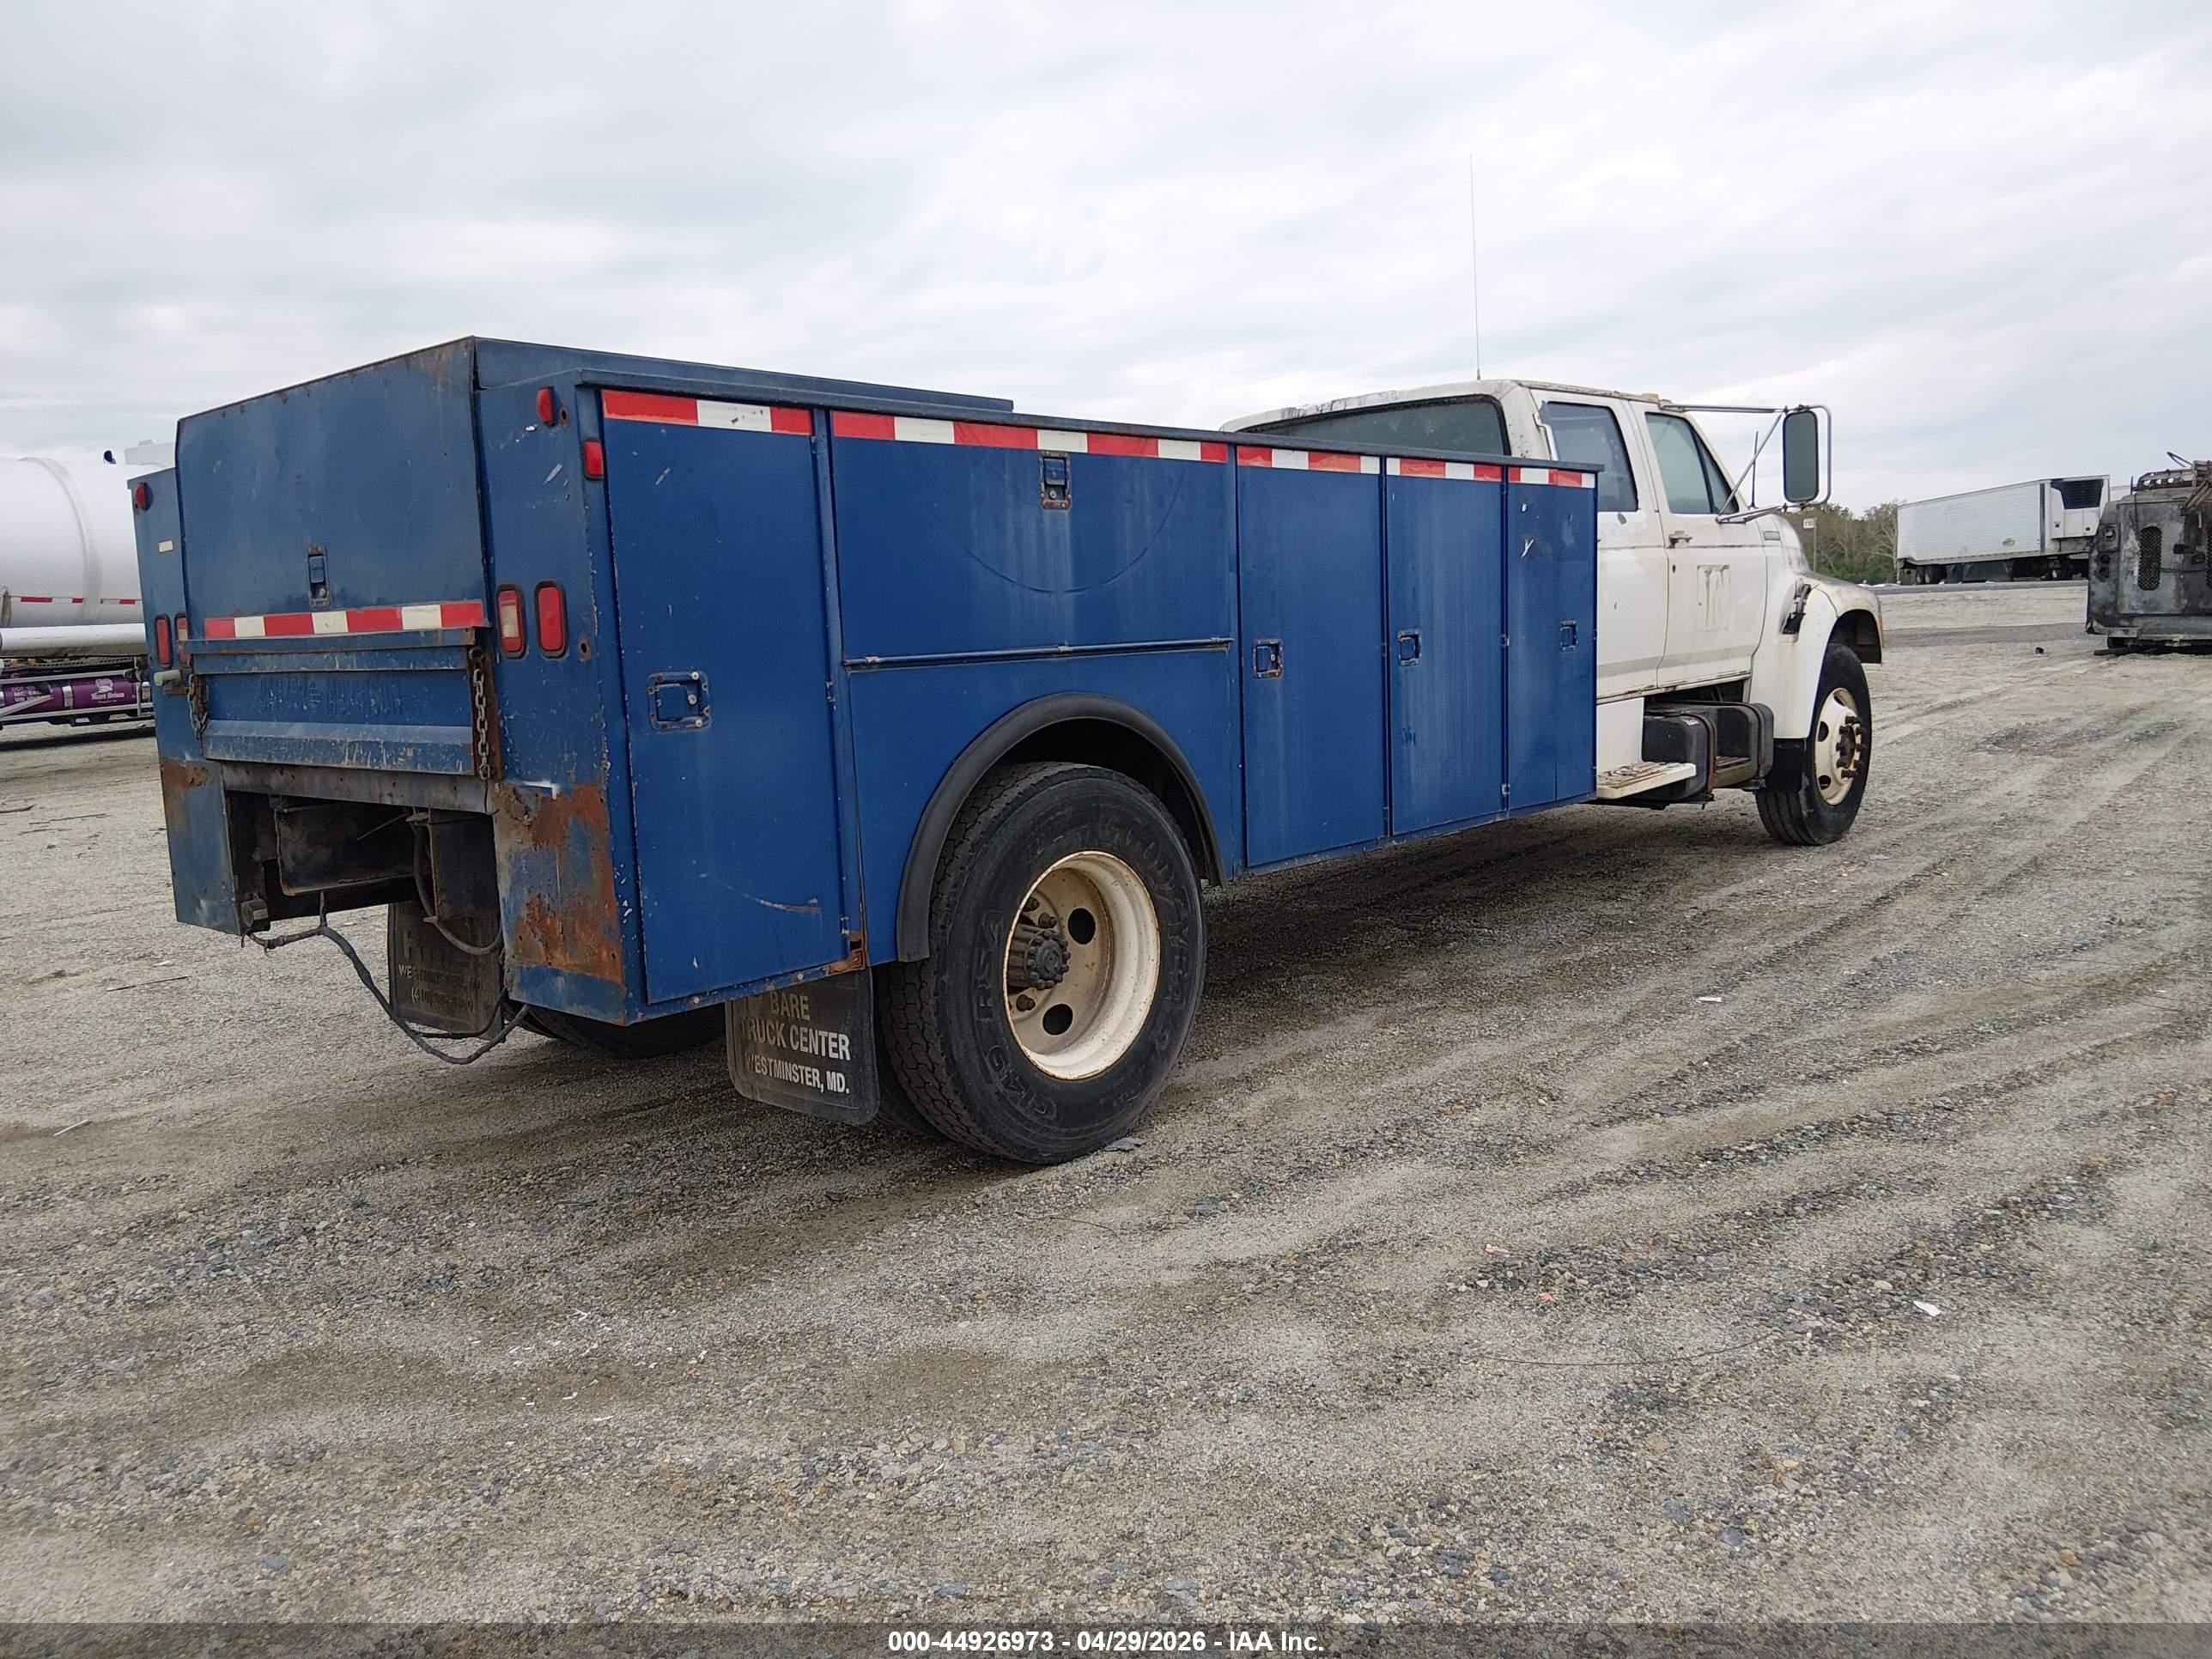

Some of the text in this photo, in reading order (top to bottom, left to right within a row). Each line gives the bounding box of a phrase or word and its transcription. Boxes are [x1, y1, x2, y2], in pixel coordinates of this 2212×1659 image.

[769, 991, 811, 1021] BARE
[741, 1016, 851, 1061] TRUCK CENTER
[826, 1070, 850, 1094] MD.
